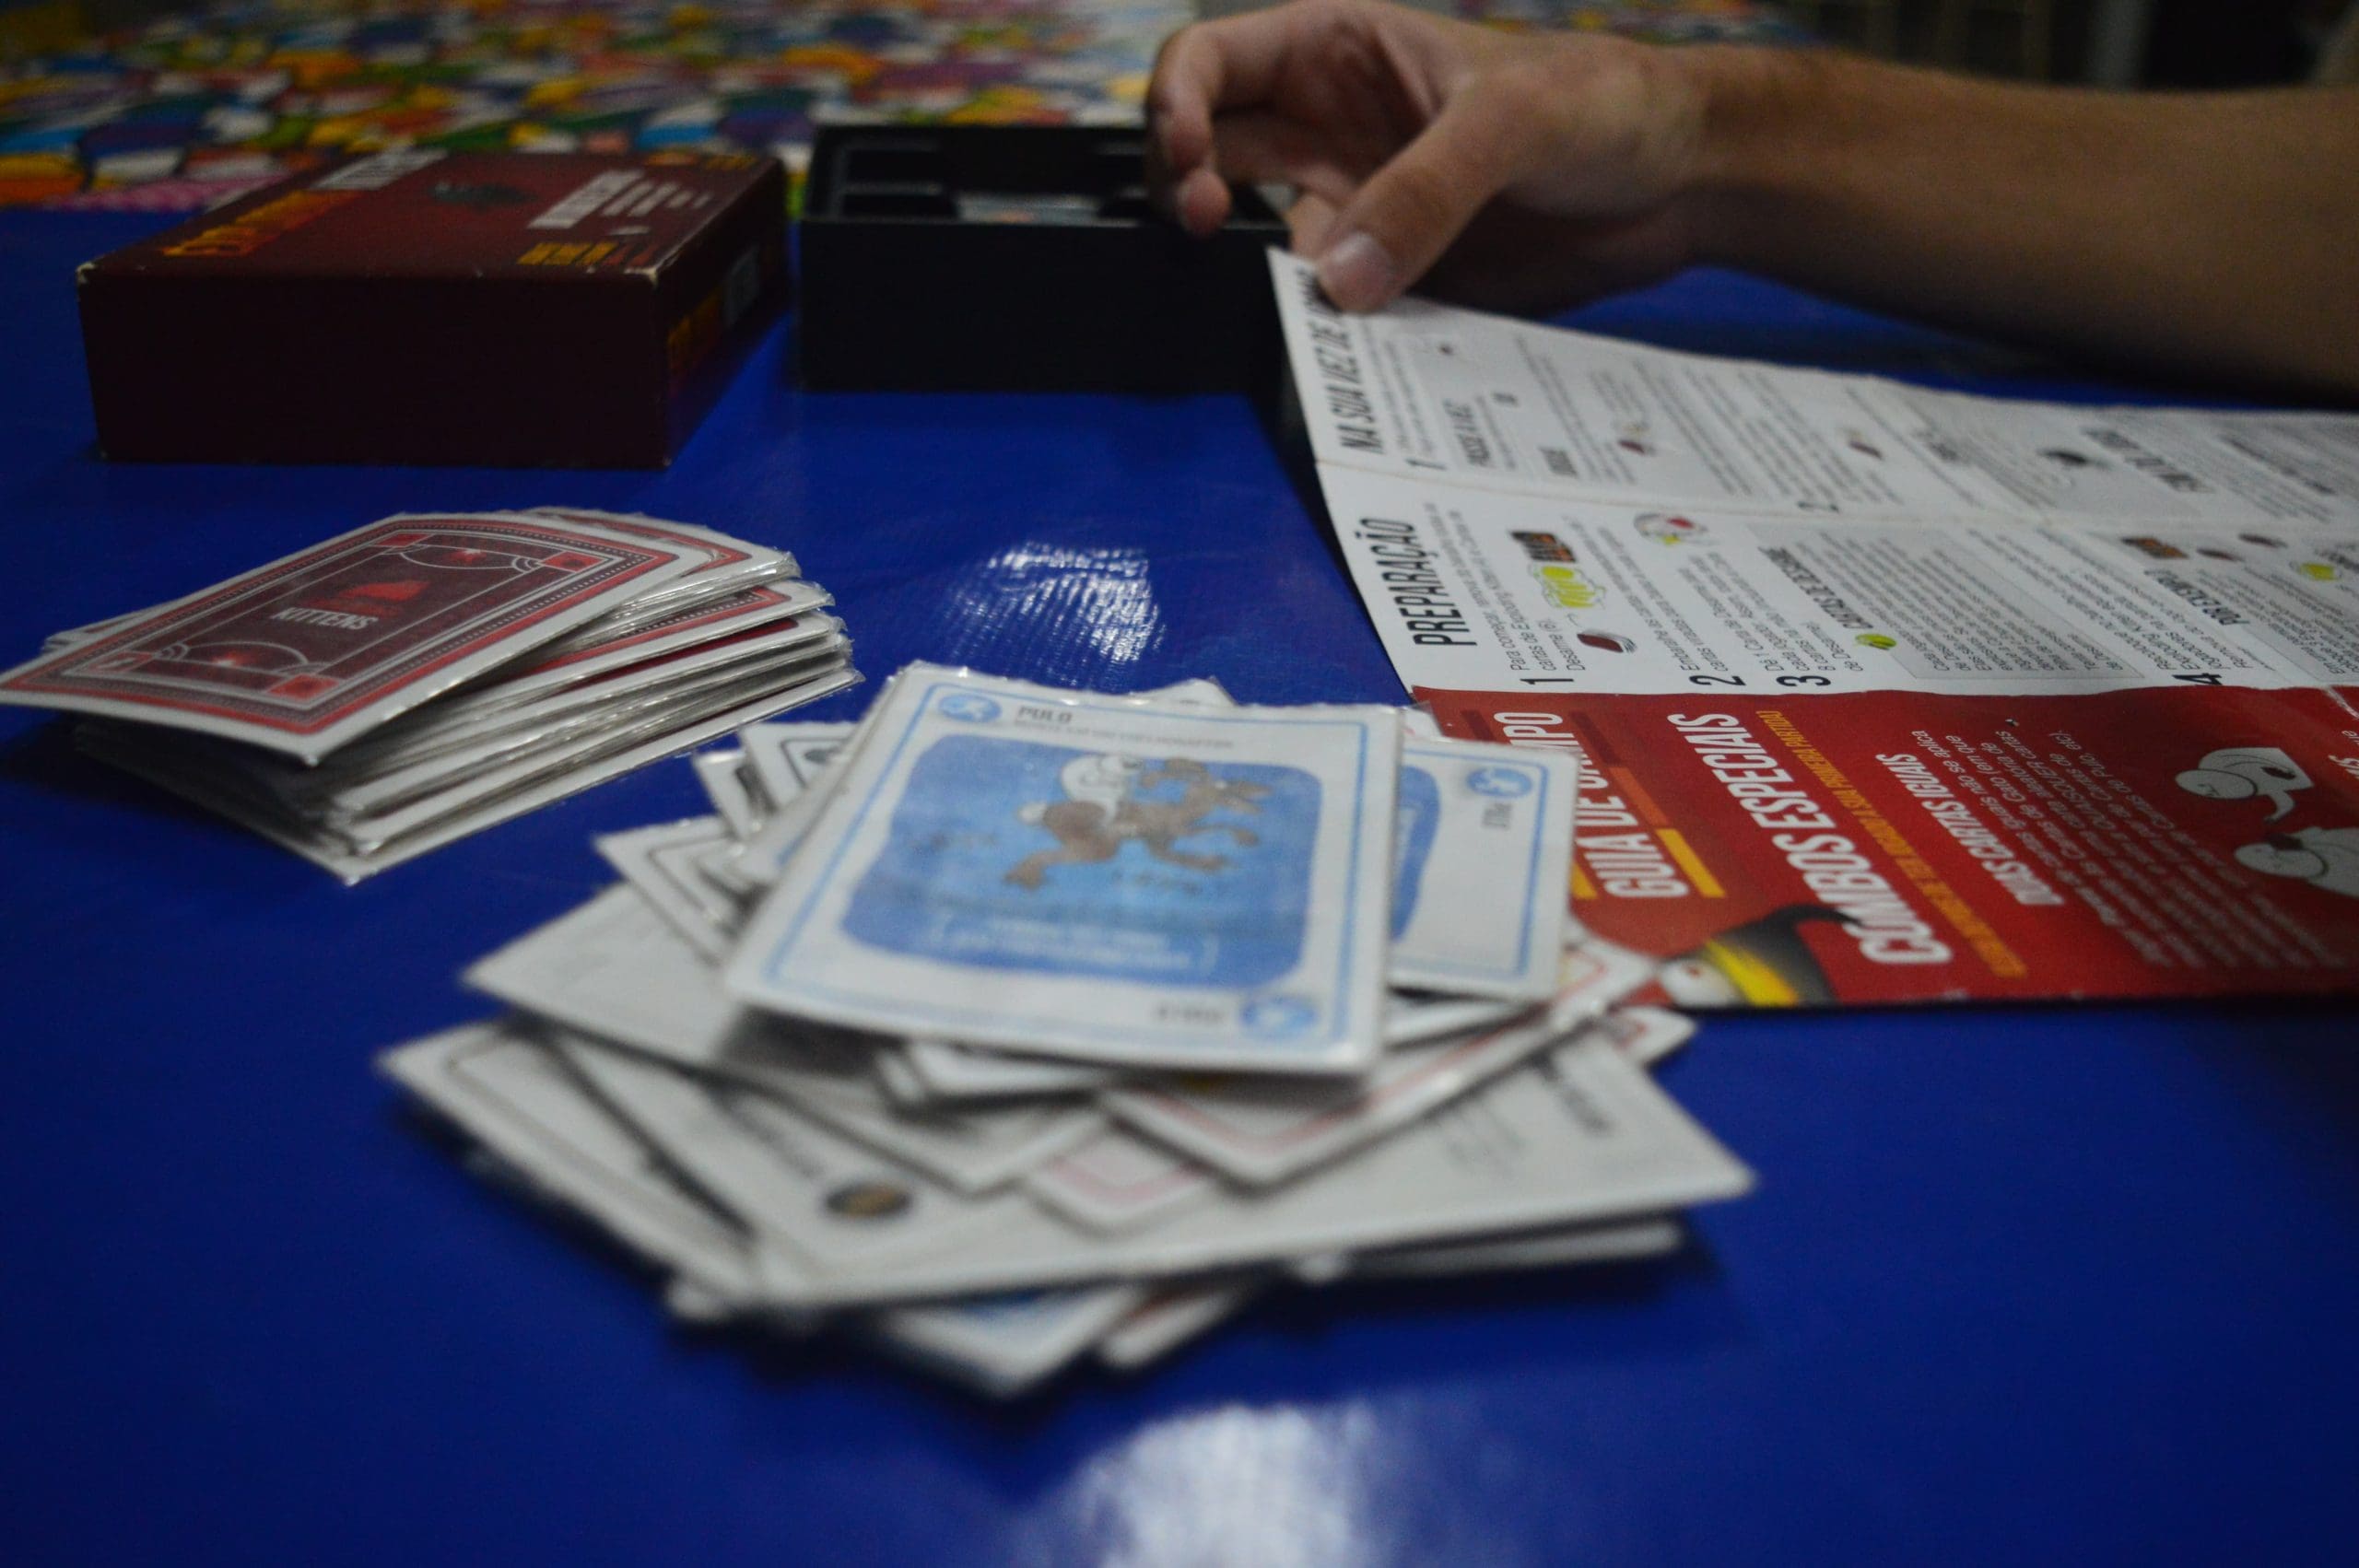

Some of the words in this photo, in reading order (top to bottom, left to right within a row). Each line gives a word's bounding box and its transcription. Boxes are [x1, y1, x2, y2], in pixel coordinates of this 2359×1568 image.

[1316, 346, 1362, 384] VEZ
[1325, 385, 1375, 423] SUA
[1337, 424, 1385, 454] NA
[1355, 519, 1477, 646] PREPARAÇÃO
[270, 605, 379, 631] KITTENS
[1491, 591, 1532, 630] Exploding
[1810, 596, 1875, 629] CARTAS
[1513, 630, 1541, 644] de
[1534, 618, 1562, 633] (6).
[1729, 628, 1766, 651] Carta
[1502, 649, 1531, 671] Para
[1524, 644, 1557, 671] cartas
[1544, 633, 1588, 671] Desarme
[1649, 628, 1702, 672] Embaralhe
[1690, 646, 1731, 672] cartas
[1778, 650, 1813, 672] cada
[1790, 639, 1830, 664] cartas
[1916, 652, 1953, 671] Cada
[1960, 655, 1994, 671] Elas
[2105, 631, 2178, 669] Recoloque
[2132, 633, 2205, 670] Exploding
[2155, 631, 2231, 670] jogadores
[1755, 658, 1786, 672] Dê
[1837, 660, 1864, 672] de
[1947, 661, 1973, 671] de
[2172, 673, 2222, 685] 4
[2315, 661, 2350, 674] Em
[1690, 675, 1745, 687] 2
[1777, 674, 1831, 687] 3
[1016, 704, 1073, 724] PULO
[1754, 708, 1813, 748] PARTIDA)
[1494, 712, 1611, 790] MPO
[1905, 727, 1957, 759] aplica
[1938, 732, 1983, 755] que
[1976, 741, 2008, 755] de
[1988, 728, 2042, 760] cartas
[2036, 725, 2088, 752] etc).
[1667, 713, 1837, 829] ESPECIAIS
[1791, 747, 1855, 790] PRIMEIRA
[1938, 758, 1968, 774] se
[1962, 753, 2005, 776] (em
[2043, 751, 2078, 767] de
[2073, 750, 2119, 779] Pulo,
[1872, 752, 1958, 800] IGUAIS
[1949, 773, 1992, 795] não
[1981, 774, 2032, 803] Gato
[1987, 754, 2059, 800] aleatória
[2060, 766, 2118, 802] Cartas
[2103, 778, 2137, 794] de
[1829, 789, 1872, 809] SUA
[2020, 758, 2122, 831] QUAISQUER
[1576, 790, 1640, 828] DE
[1973, 794, 2035, 831] iguais
[2012, 802, 2050, 820] de
[1918, 800, 2017, 860] CARTAS
[1575, 833, 1691, 899] GUIA
[1978, 860, 2070, 907] DUAS
[1773, 833, 1954, 965] COMBOS
